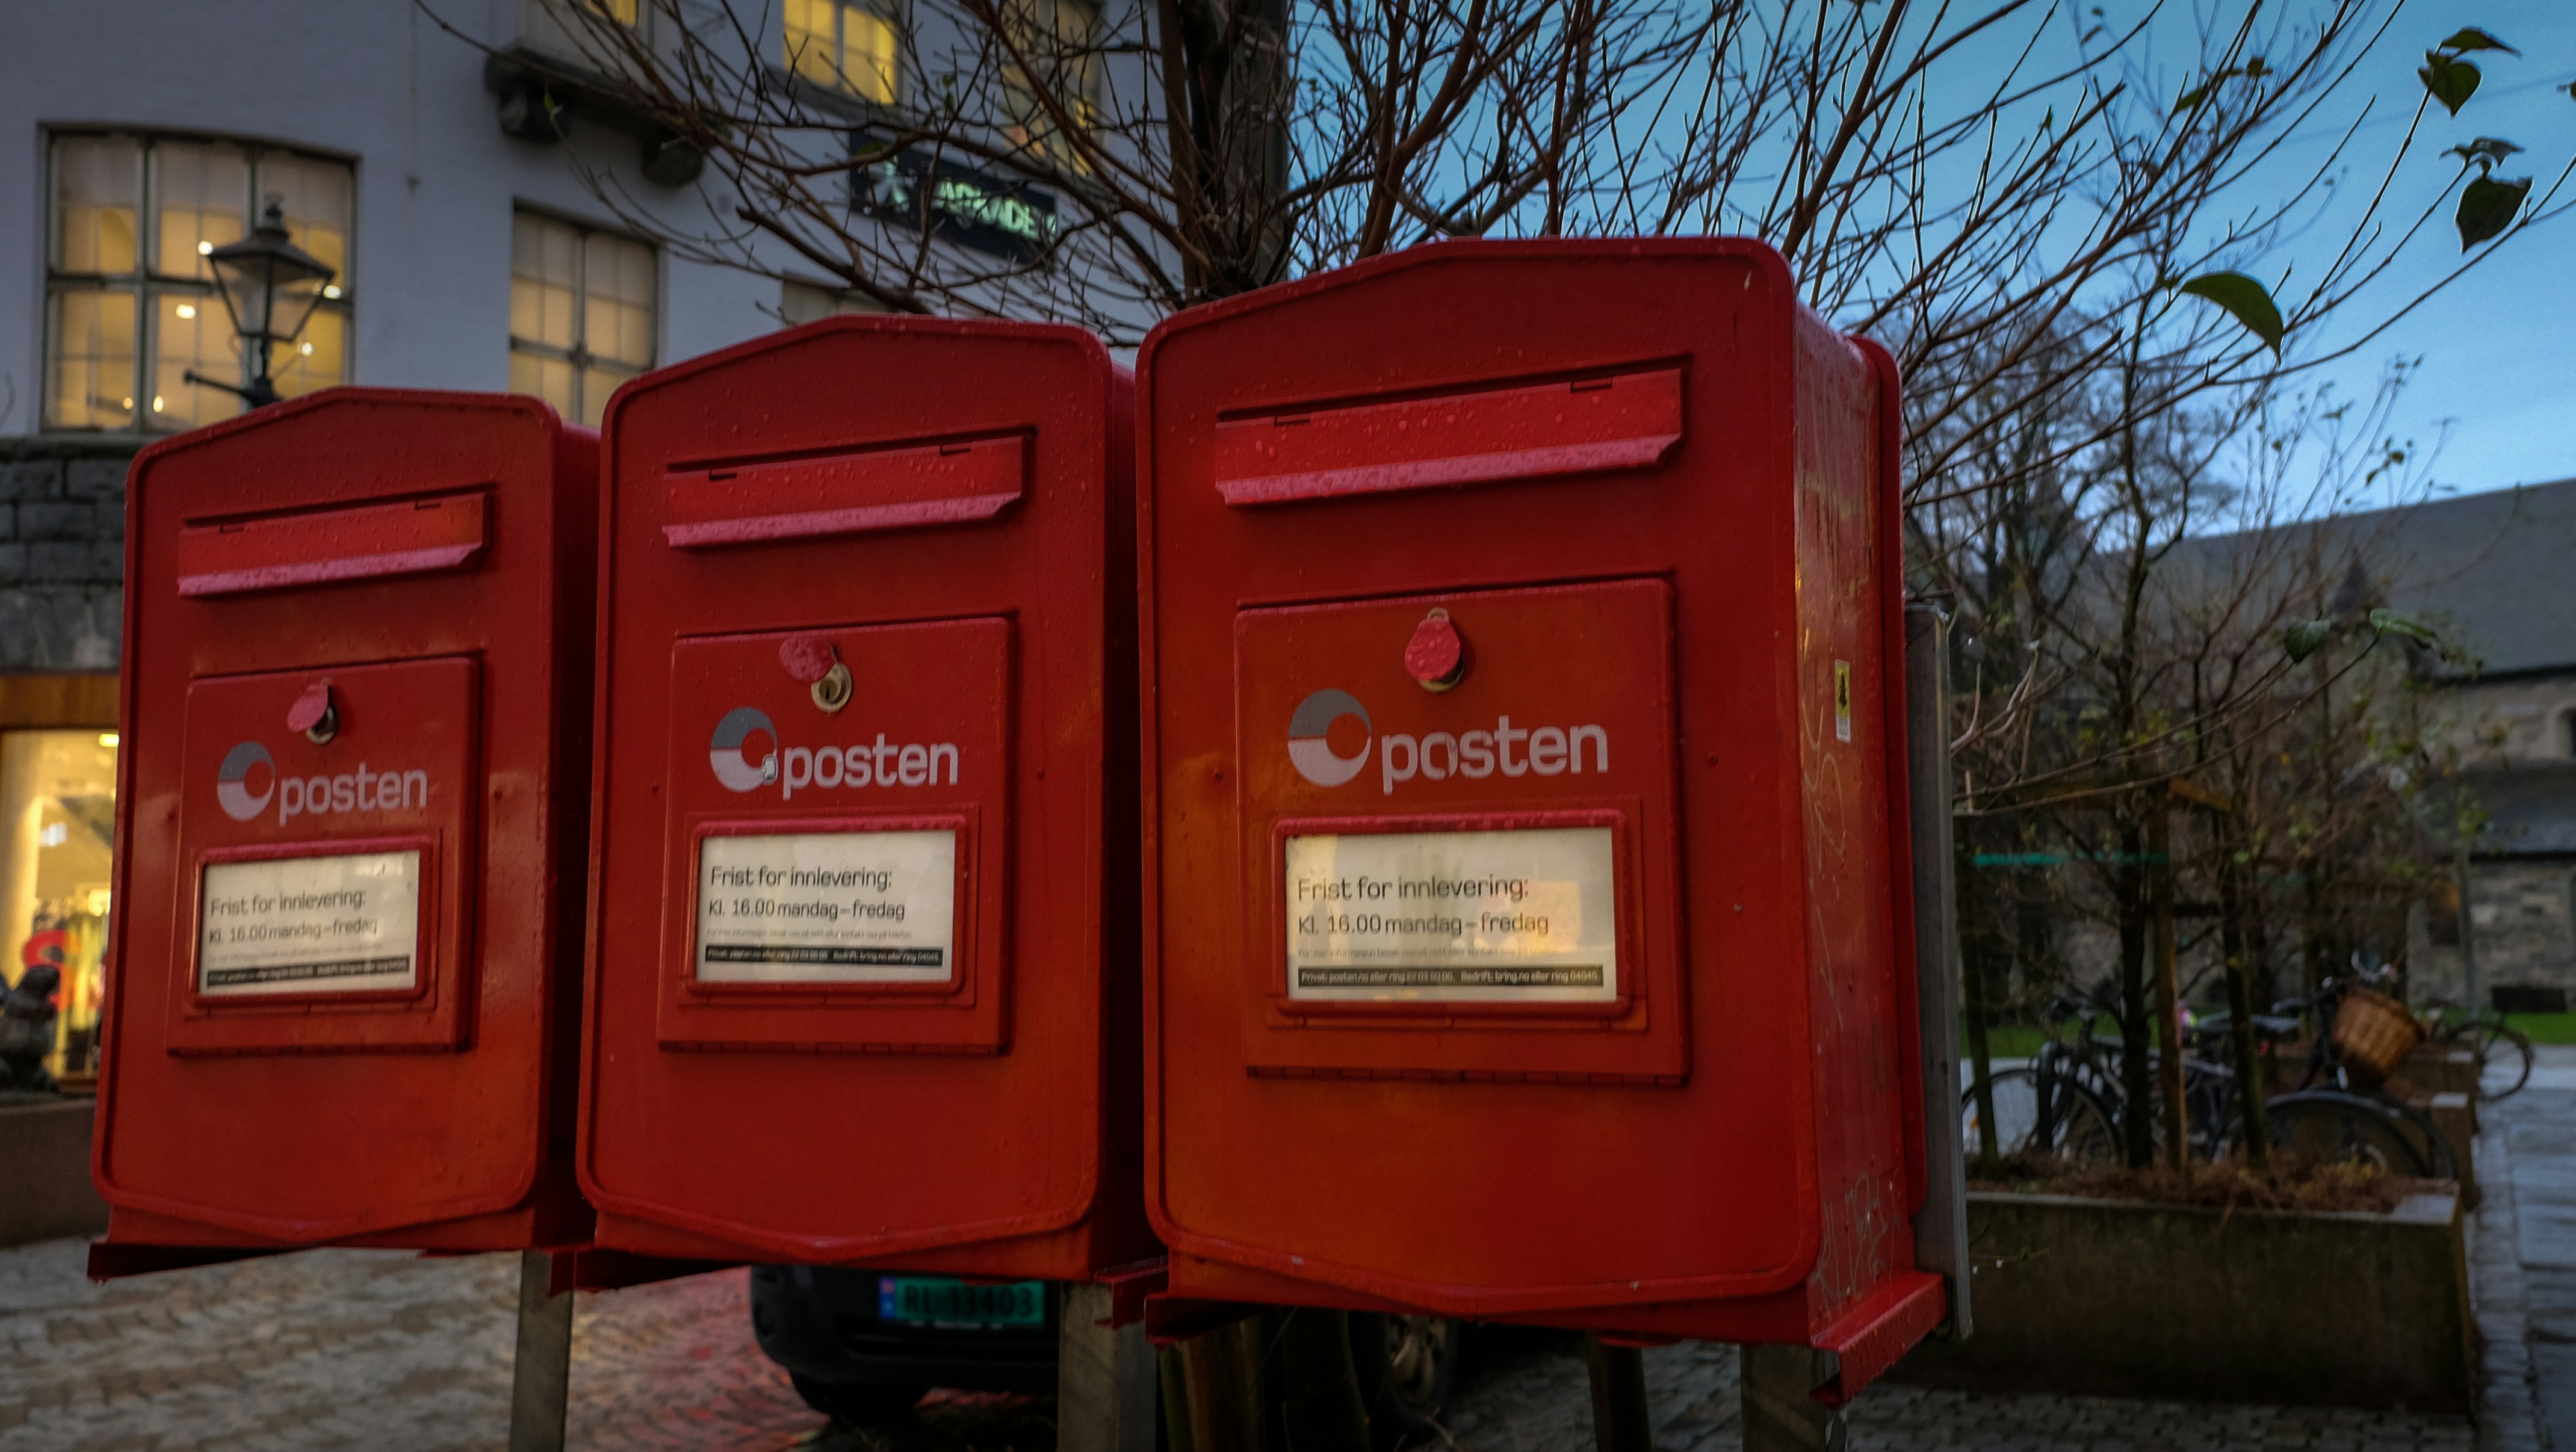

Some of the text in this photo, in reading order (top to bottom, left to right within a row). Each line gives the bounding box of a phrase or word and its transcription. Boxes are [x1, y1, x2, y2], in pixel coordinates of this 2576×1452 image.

[782, 732, 959, 801] posten
[1382, 715, 1608, 796] posten
[279, 762, 428, 826] posten
[711, 865, 892, 894] Frist for innlevering:
[1298, 873, 1528, 903] Frist for innlevering:
[211, 897, 248, 917] Frist
[252, 893, 276, 914] for
[732, 898, 775, 918] 16.00
[1298, 914, 1318, 935] Kl.
[1328, 913, 1381, 935] 16.00
